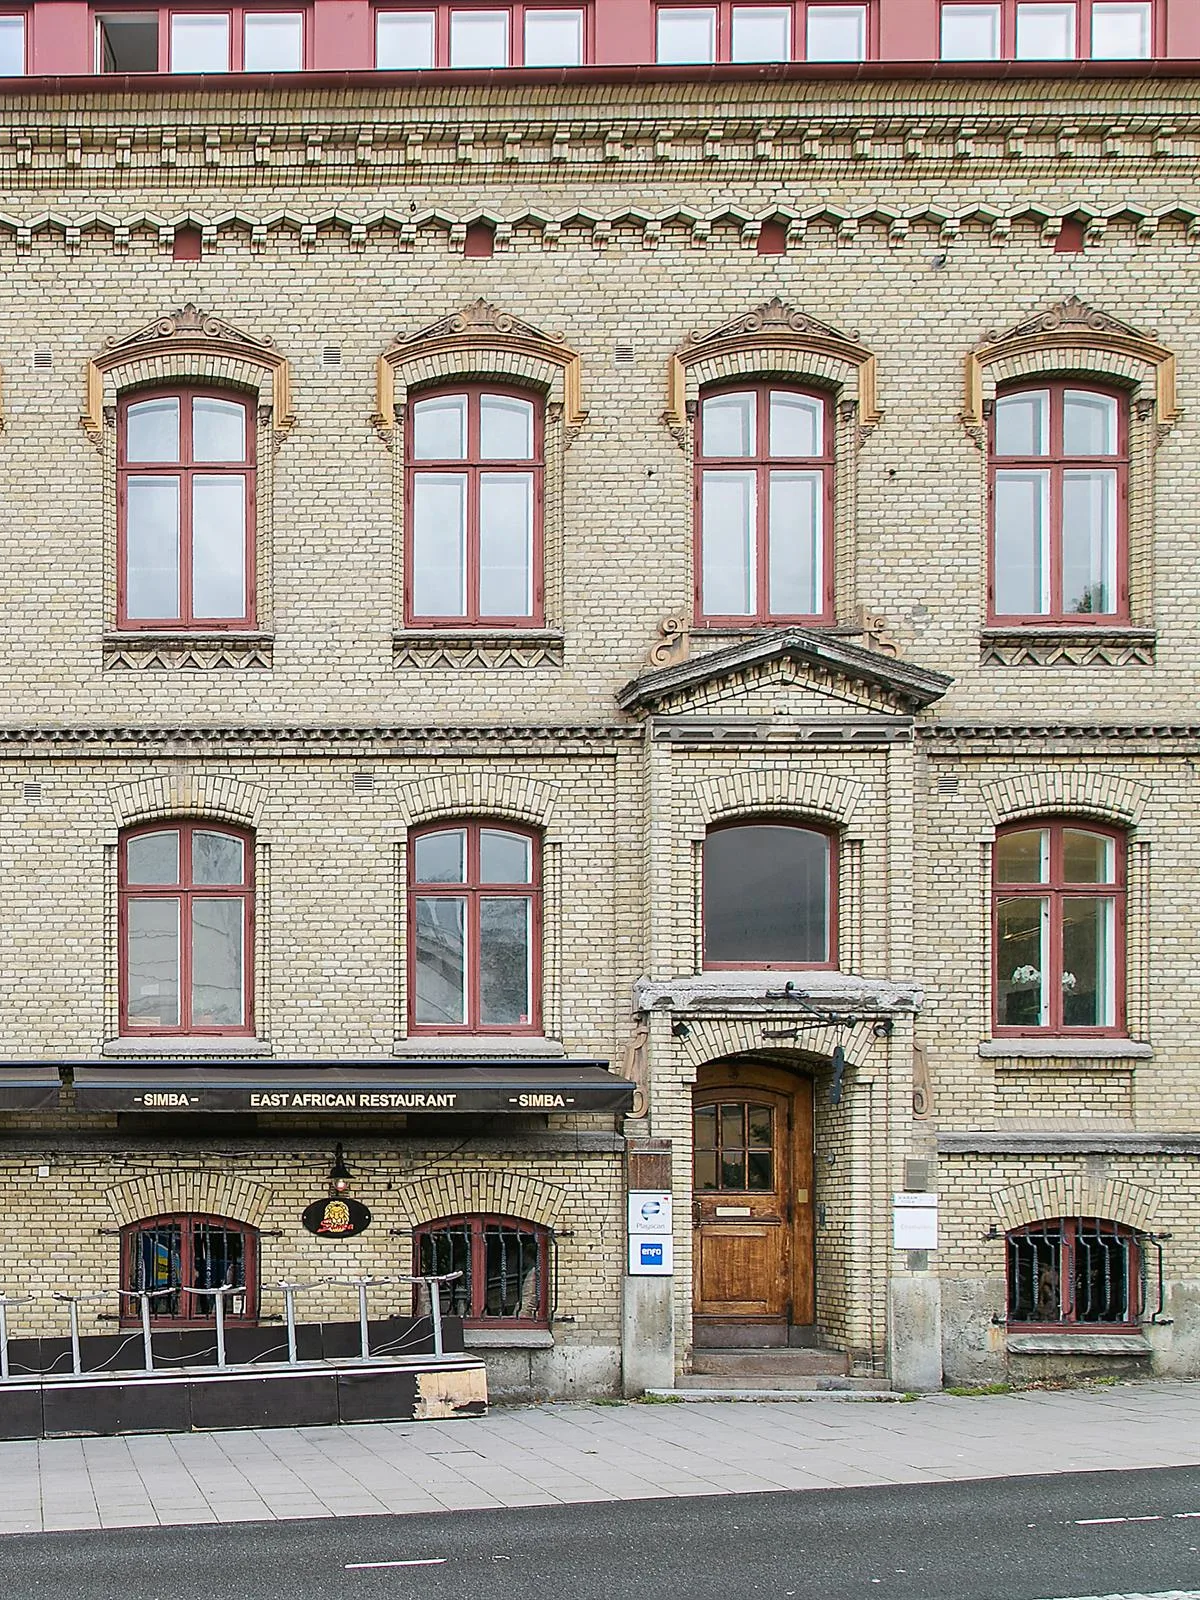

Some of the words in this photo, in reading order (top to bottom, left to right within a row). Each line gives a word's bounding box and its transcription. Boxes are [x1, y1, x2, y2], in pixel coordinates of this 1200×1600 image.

[250, 1094, 289, 1106] EAST
[291, 1094, 356, 1107] AFRICAN
[359, 1094, 457, 1107] RESTAURANT
[641, 1248, 662, 1257] enfo
